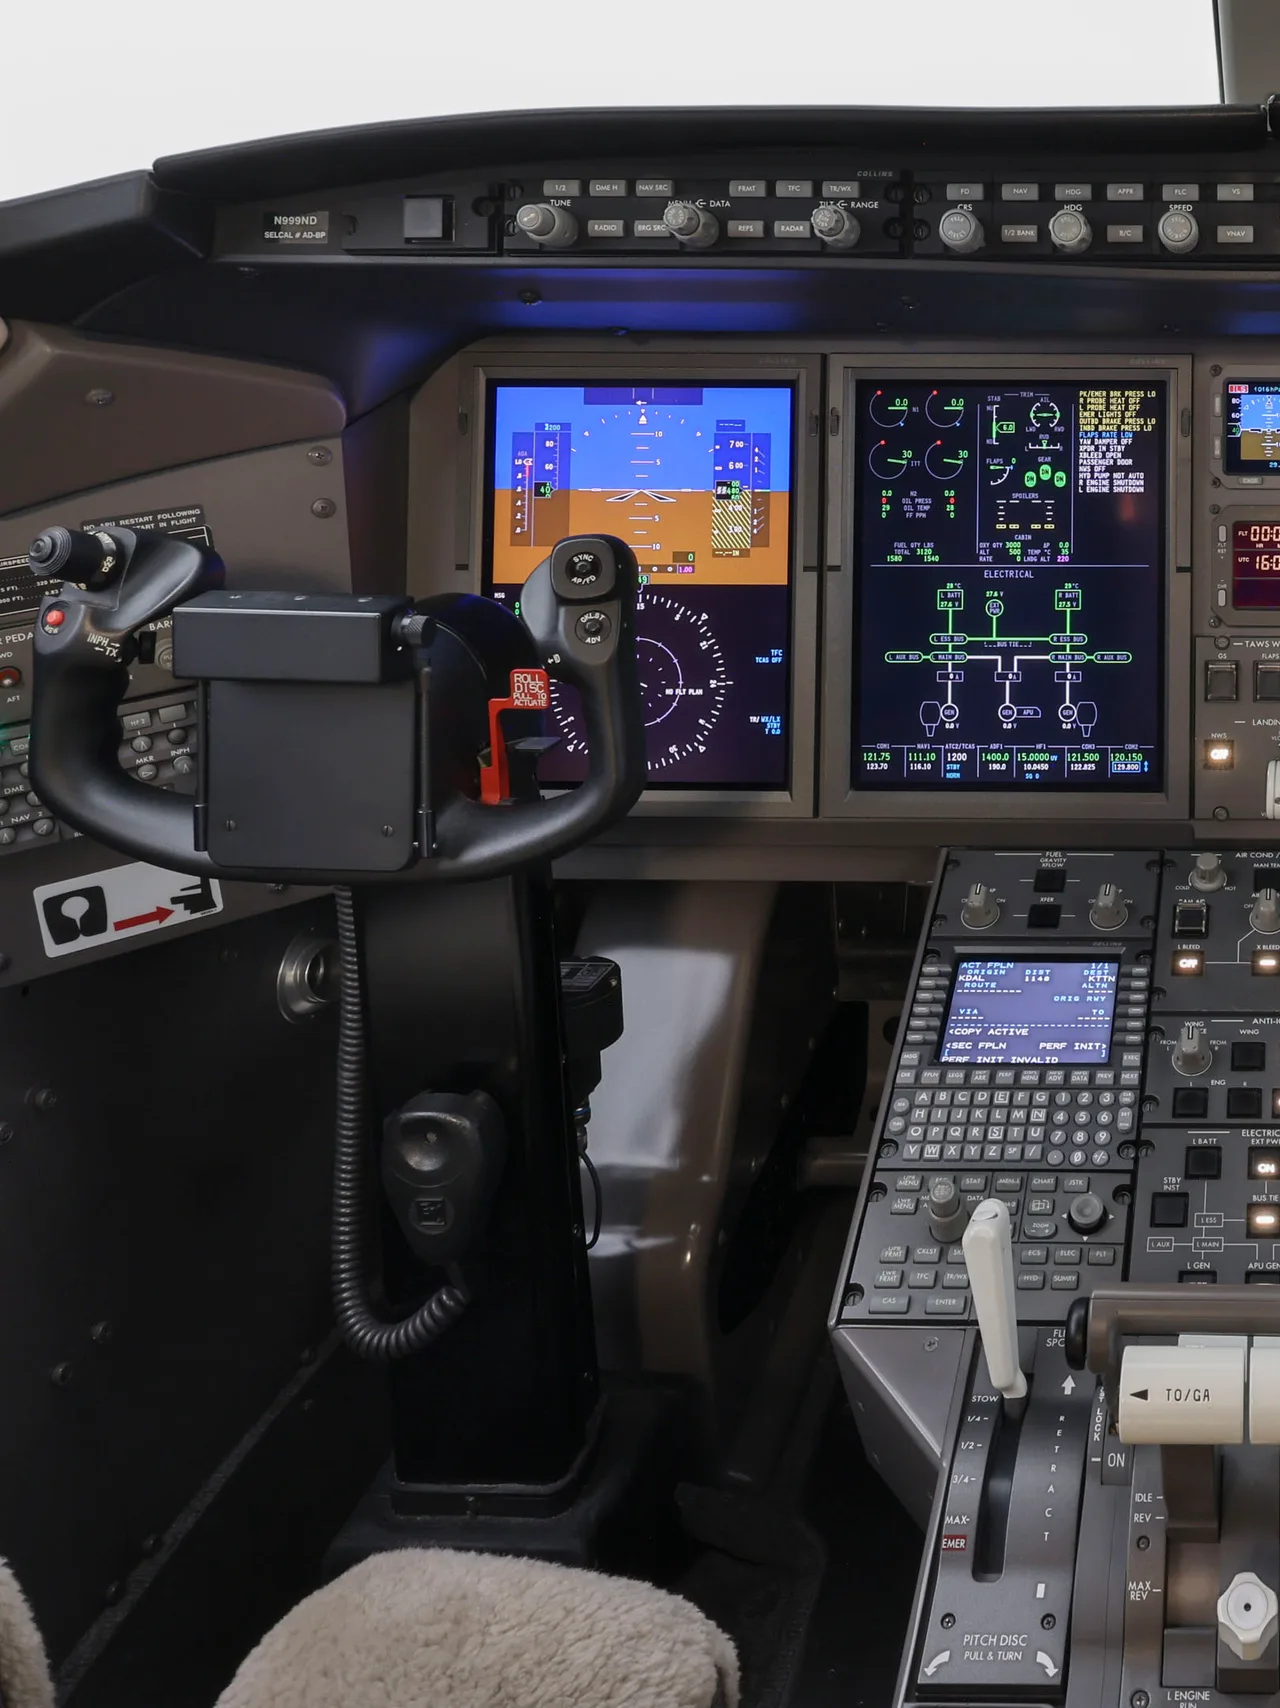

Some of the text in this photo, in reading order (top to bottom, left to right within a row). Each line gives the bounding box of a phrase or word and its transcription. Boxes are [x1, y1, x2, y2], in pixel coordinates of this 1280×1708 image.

[550, 199, 571, 207] TUNE
[709, 200, 731, 208] DATA
[850, 201, 879, 209] RANGE
[1169, 204, 1193, 212] SPEED
[274, 215, 317, 226] N999ND
[594, 224, 617, 232] RADIO
[264, 231, 292, 239] SELCAL
[119, 508, 201, 526] RESTART FOLLOWING
[573, 554, 594, 563] SYNC
[984, 570, 1034, 579] ELECTRICAL
[87, 633, 109, 647] INPH
[585, 636, 601, 644] ADV
[514, 674, 544, 683] ROLL
[515, 683, 544, 693] DISC
[863, 753, 891, 761] 121.75
[908, 753, 936, 761] 111.10
[947, 753, 967, 761] 1200
[981, 753, 1009, 761] 1400.0
[987, 1028, 1029, 1036] ACTIVE
[1011, 1056, 1058, 1064] INVALID
[1165, 1389, 1211, 1402] TO/GA
[1107, 1453, 1125, 1468] ON
[1135, 1492, 1153, 1502] IDLE
[942, 1538, 966, 1549] EMER
[963, 1634, 1027, 1647] PITCH DISC
[964, 1651, 1022, 1661] PULL & TURN
[1167, 1691, 1210, 1701] L ENGINE
